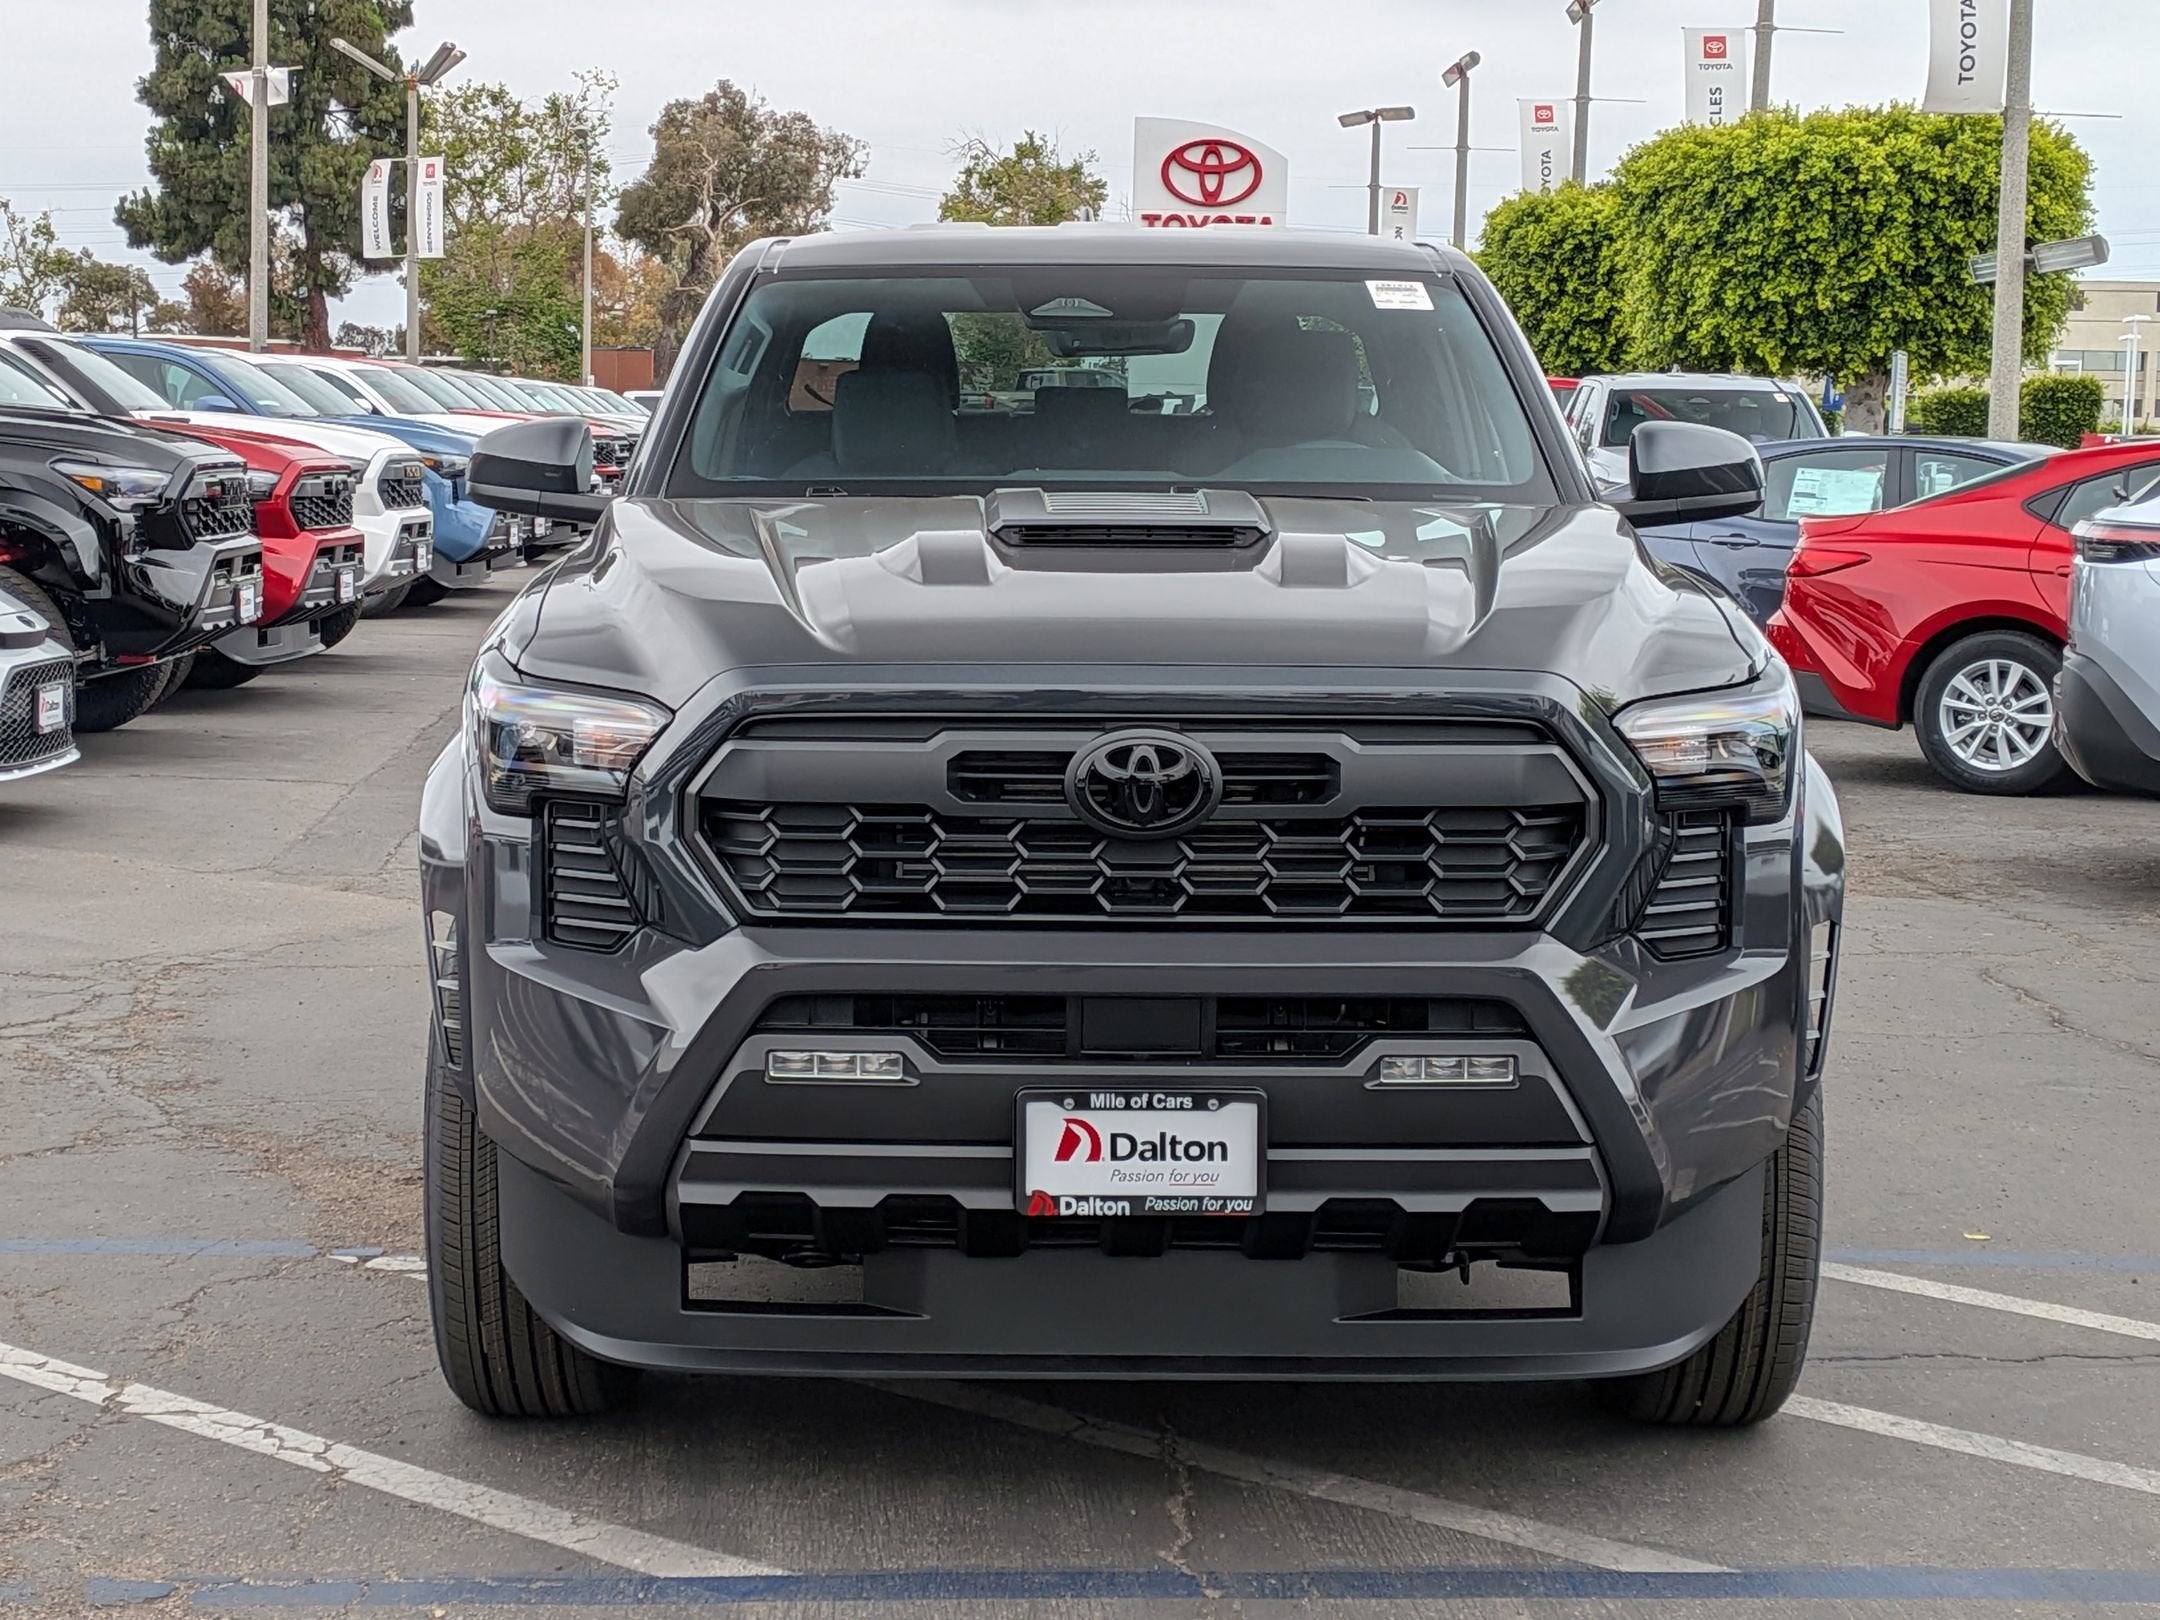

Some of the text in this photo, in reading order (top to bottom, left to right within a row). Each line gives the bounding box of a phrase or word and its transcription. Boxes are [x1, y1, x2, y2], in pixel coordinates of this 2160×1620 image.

[1958, 0, 1977, 86] TOYOTA
[1698, 63, 1733, 71] TOYOTA
[1709, 86, 1723, 127] CLES
[1540, 149, 1552, 197] OYOTA
[372, 195, 382, 251] WELCOME
[1090, 1093, 1193, 1109] Mile of Cars
[1110, 1131, 1228, 1162] Dalton
[1110, 1168, 1220, 1185] Passion for you
[1060, 1196, 1131, 1216] Dalton
[1145, 1196, 1253, 1213] Passion for you
